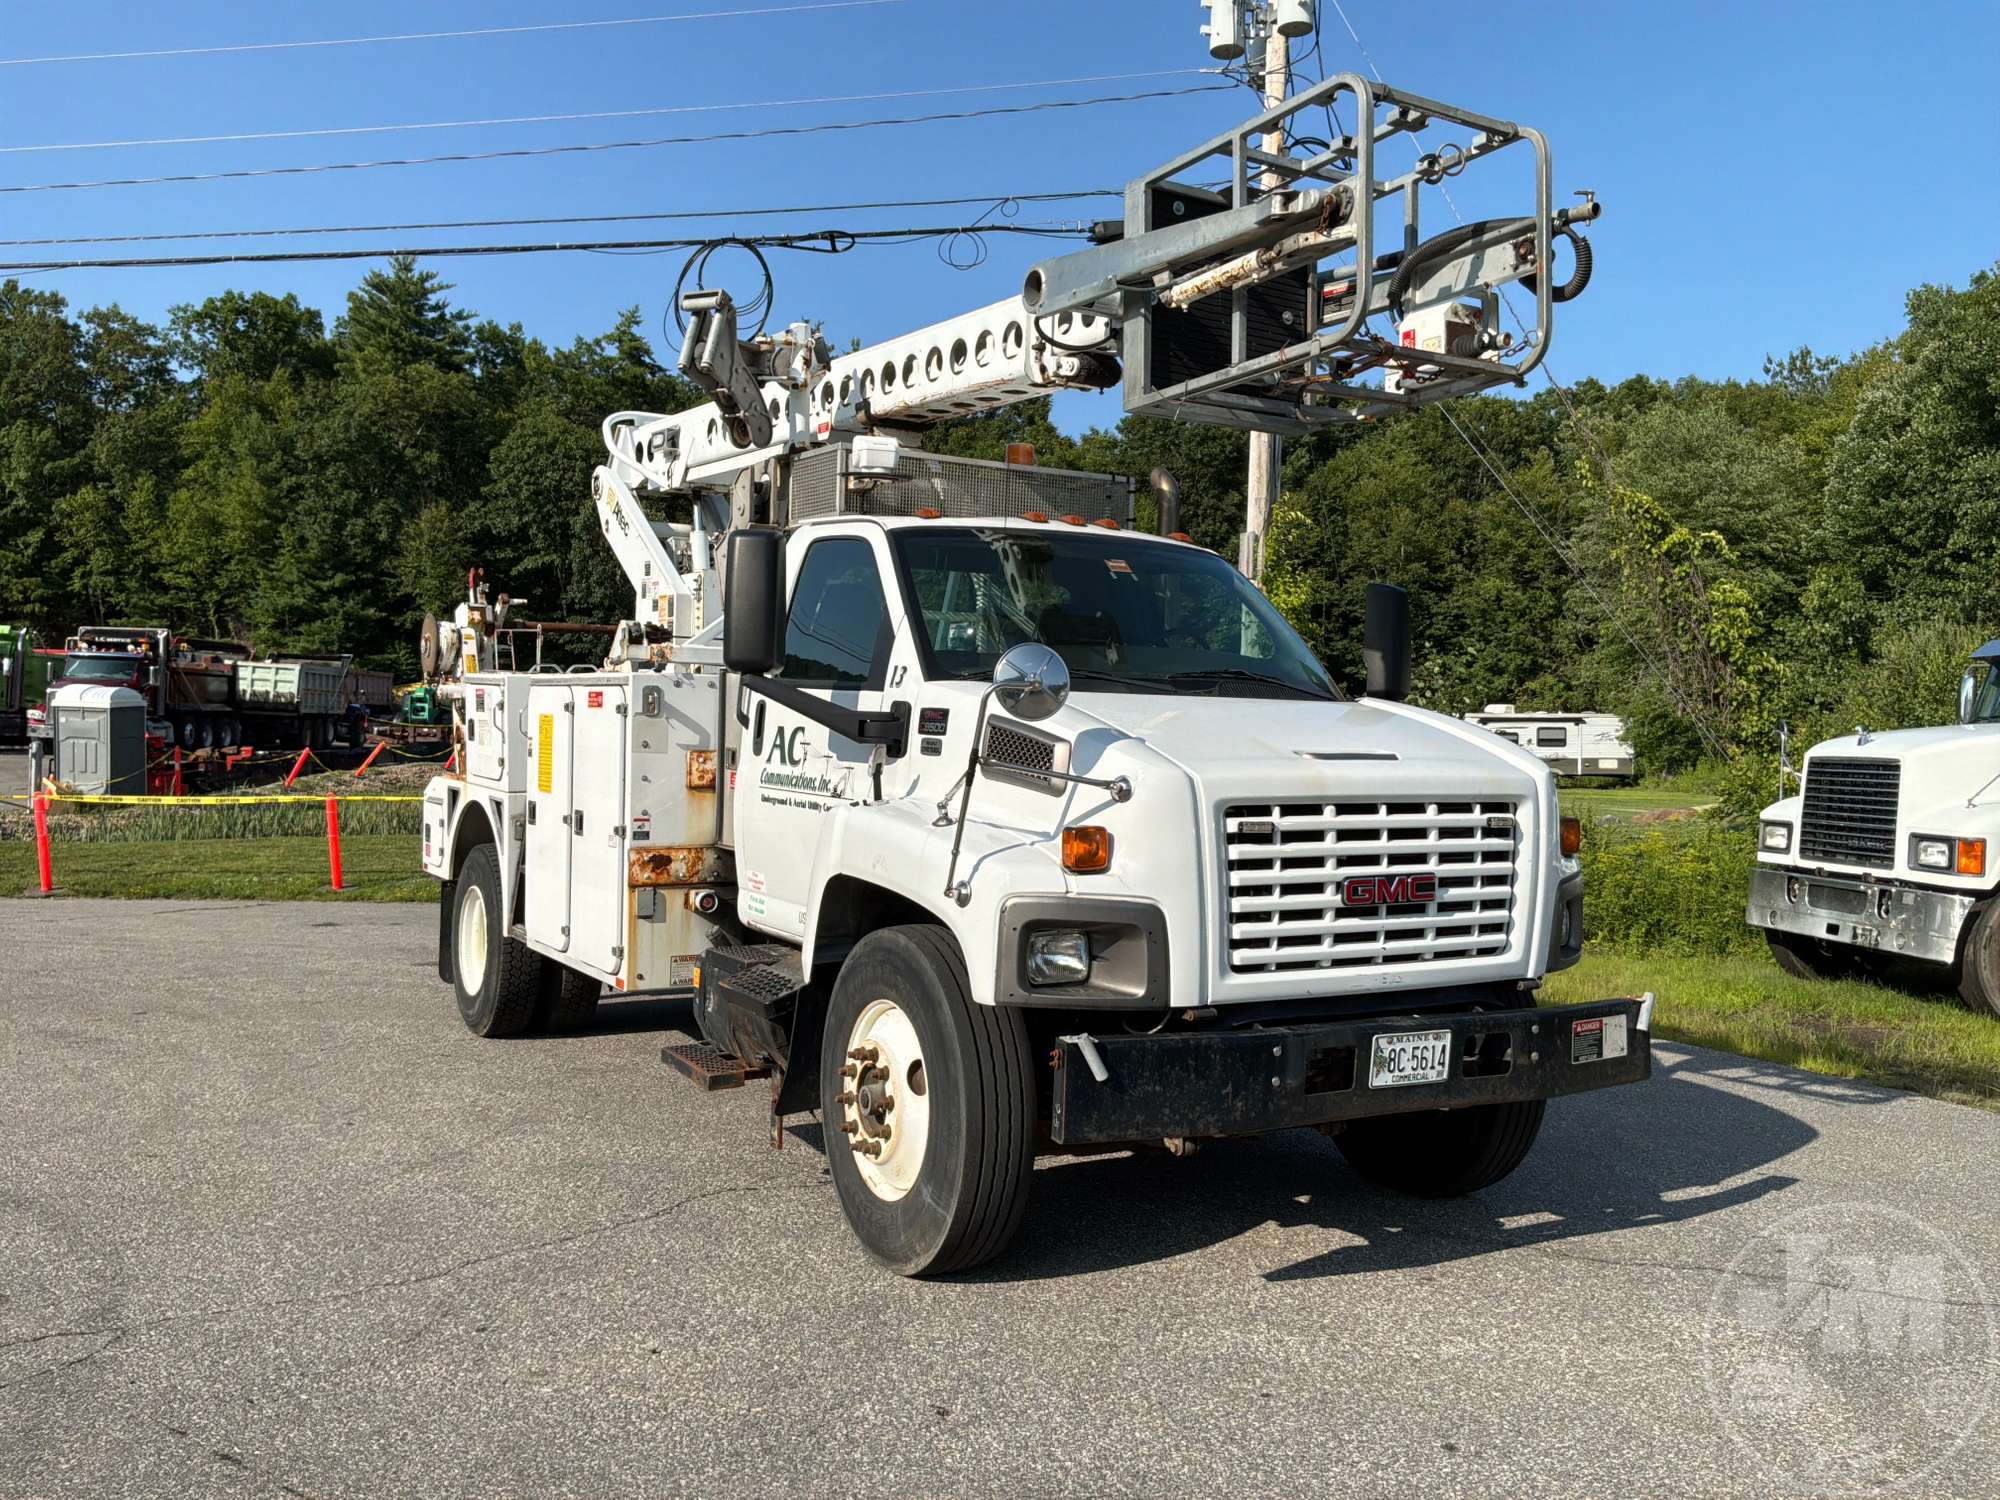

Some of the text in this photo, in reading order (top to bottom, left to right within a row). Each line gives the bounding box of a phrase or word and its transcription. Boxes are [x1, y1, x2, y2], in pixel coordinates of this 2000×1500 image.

[889, 665, 908, 688] 13
[765, 726, 806, 767] AC
[818, 774, 832, 793] Inc.
[1344, 875, 1437, 905] GMC
[1582, 1021, 1600, 1030] DANGER
[1396, 1033, 1430, 1043] MAINE
[1391, 1072, 1430, 1083] COMMERCIAL
